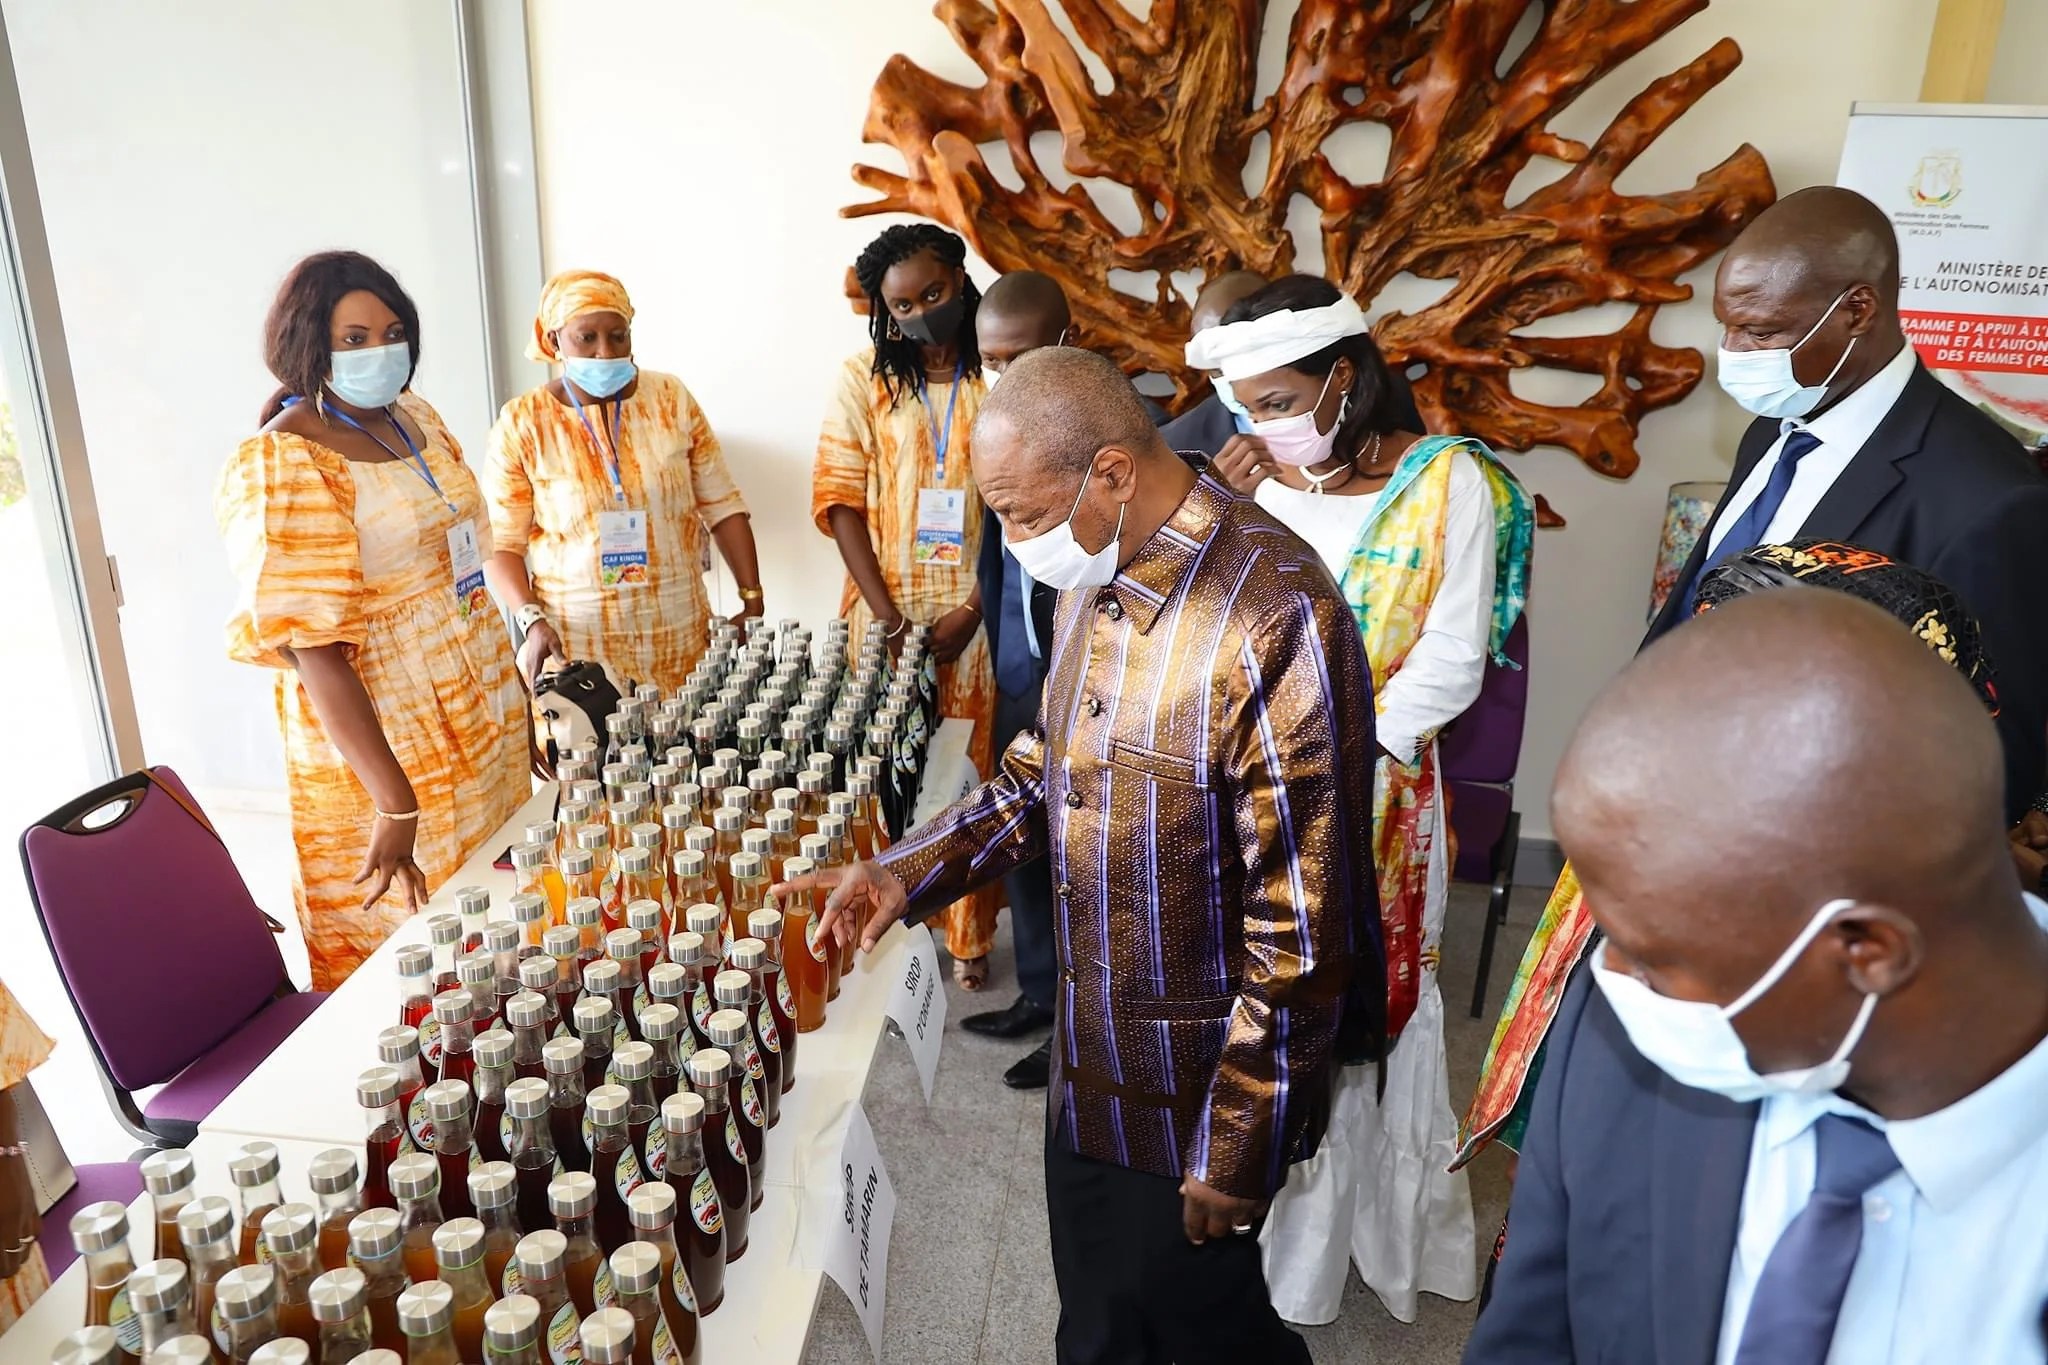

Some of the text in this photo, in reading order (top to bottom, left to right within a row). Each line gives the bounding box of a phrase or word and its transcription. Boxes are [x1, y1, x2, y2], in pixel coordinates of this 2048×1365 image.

[1937, 260, 2048, 279] MINISTÈRE DE
[1899, 276, 1908, 289] E
[1900, 317, 1956, 332] RAMME
[1958, 321, 2017, 335] D'APPUI
[2018, 321, 2029, 336] À
[1953, 335, 1971, 348] ET
[1972, 334, 1984, 348] À
[1937, 349, 1965, 362] DES
[1968, 351, 2024, 365] FEMMES
[905, 955, 922, 997] SIROP
[845, 1163, 854, 1234] SIROP
[859, 1165, 878, 1309] DE TAMARIN
